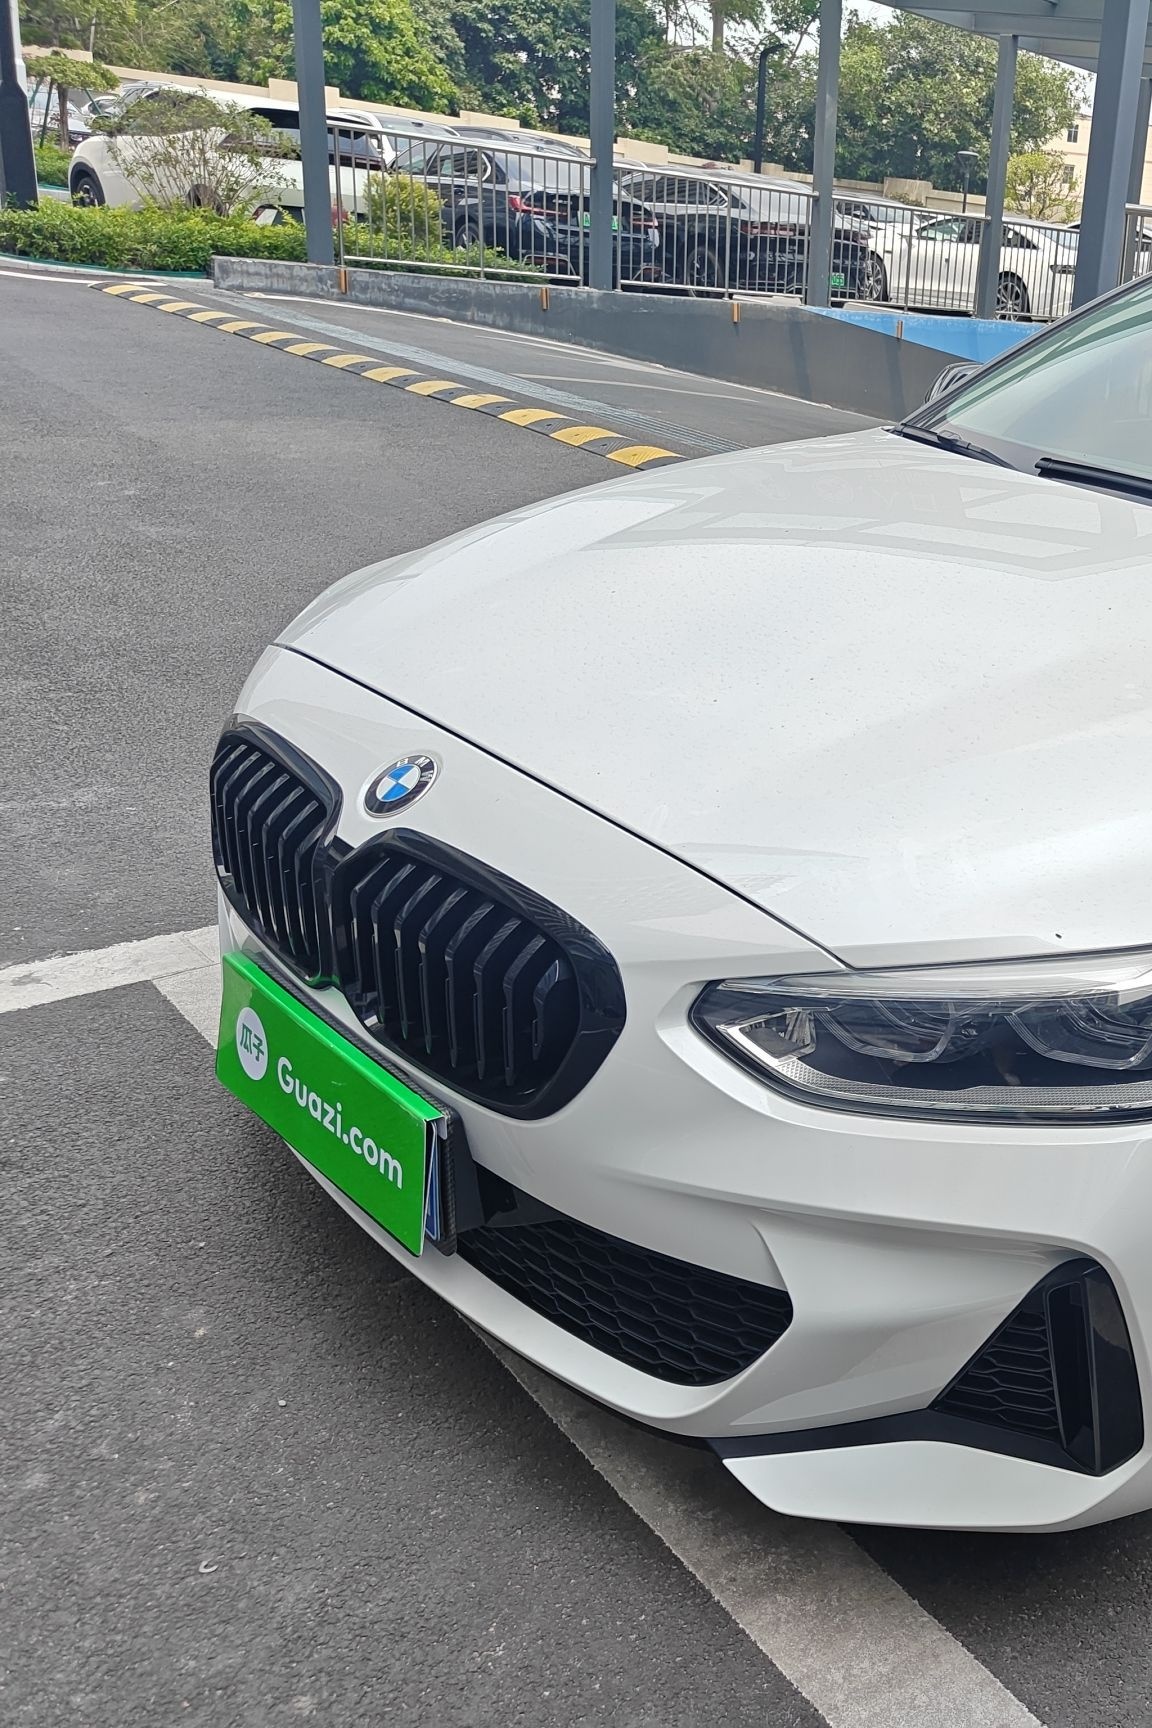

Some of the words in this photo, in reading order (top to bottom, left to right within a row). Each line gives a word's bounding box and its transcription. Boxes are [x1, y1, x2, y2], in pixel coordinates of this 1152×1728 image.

[396, 756, 434, 782] BMW
[239, 1023, 265, 1062] 瓜子
[277, 1056, 403, 1190] Guazi.com
